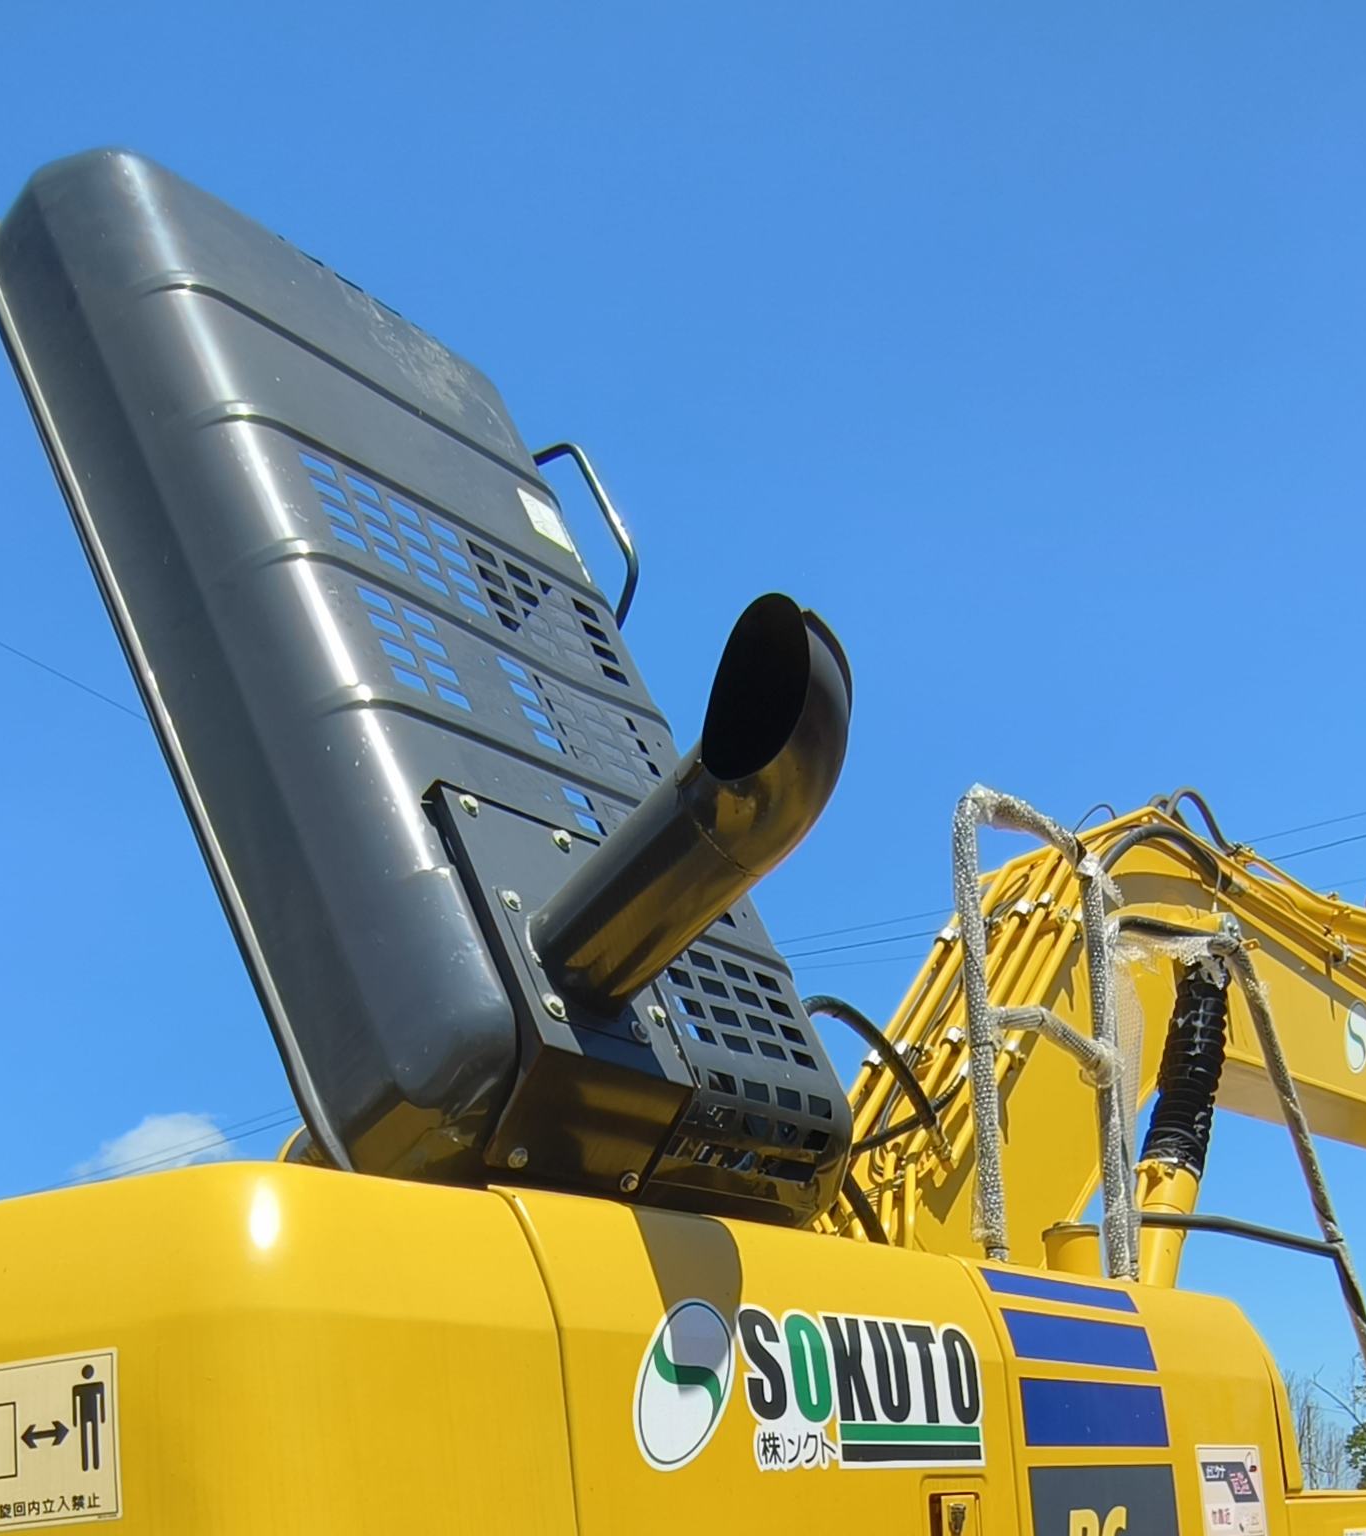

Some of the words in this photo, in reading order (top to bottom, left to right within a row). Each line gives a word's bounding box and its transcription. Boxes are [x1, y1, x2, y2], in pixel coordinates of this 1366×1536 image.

[738, 1308, 981, 1425] SOKUTO
[0, 1492, 101, 1519] 旋回内立入禁止
